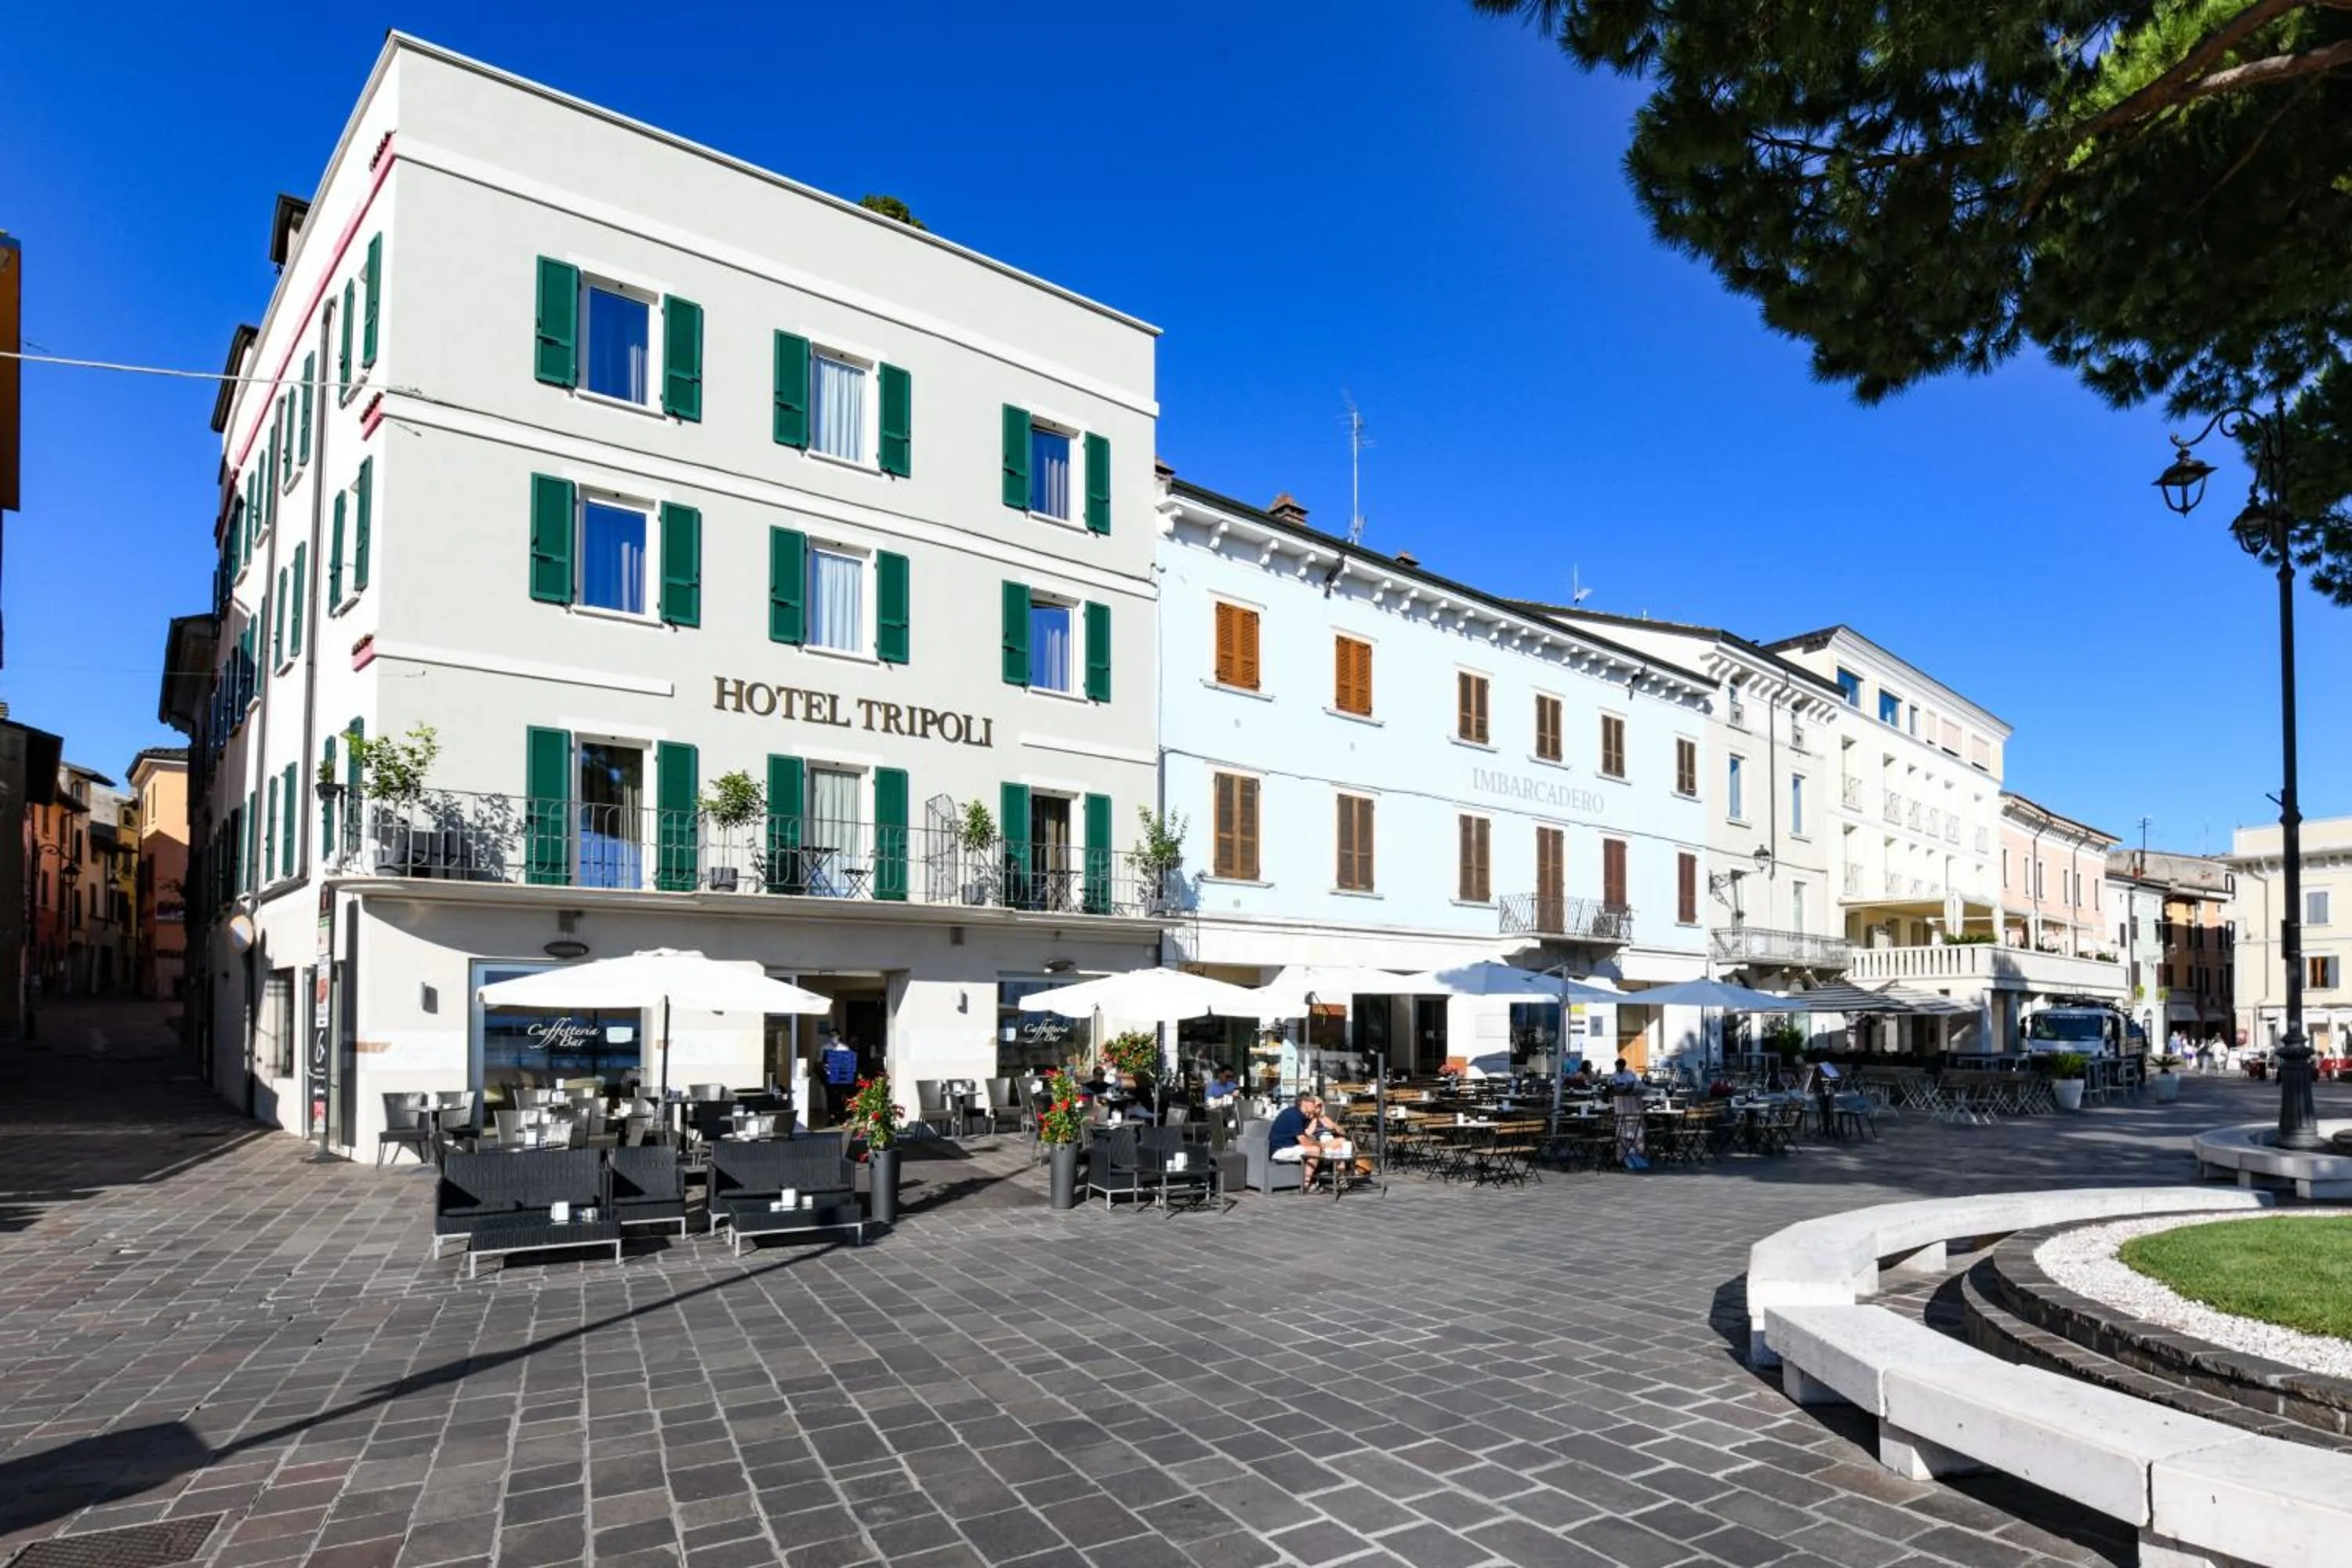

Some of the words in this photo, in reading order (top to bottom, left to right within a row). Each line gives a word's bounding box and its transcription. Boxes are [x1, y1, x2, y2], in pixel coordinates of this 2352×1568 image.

[713, 676, 851, 728] HOTEL
[857, 697, 994, 748] TRIPOLI
[1472, 767, 1605, 814] IMBARCADERO
[527, 1017, 600, 1049] Caffetteria
[559, 1036, 586, 1047] Bar
